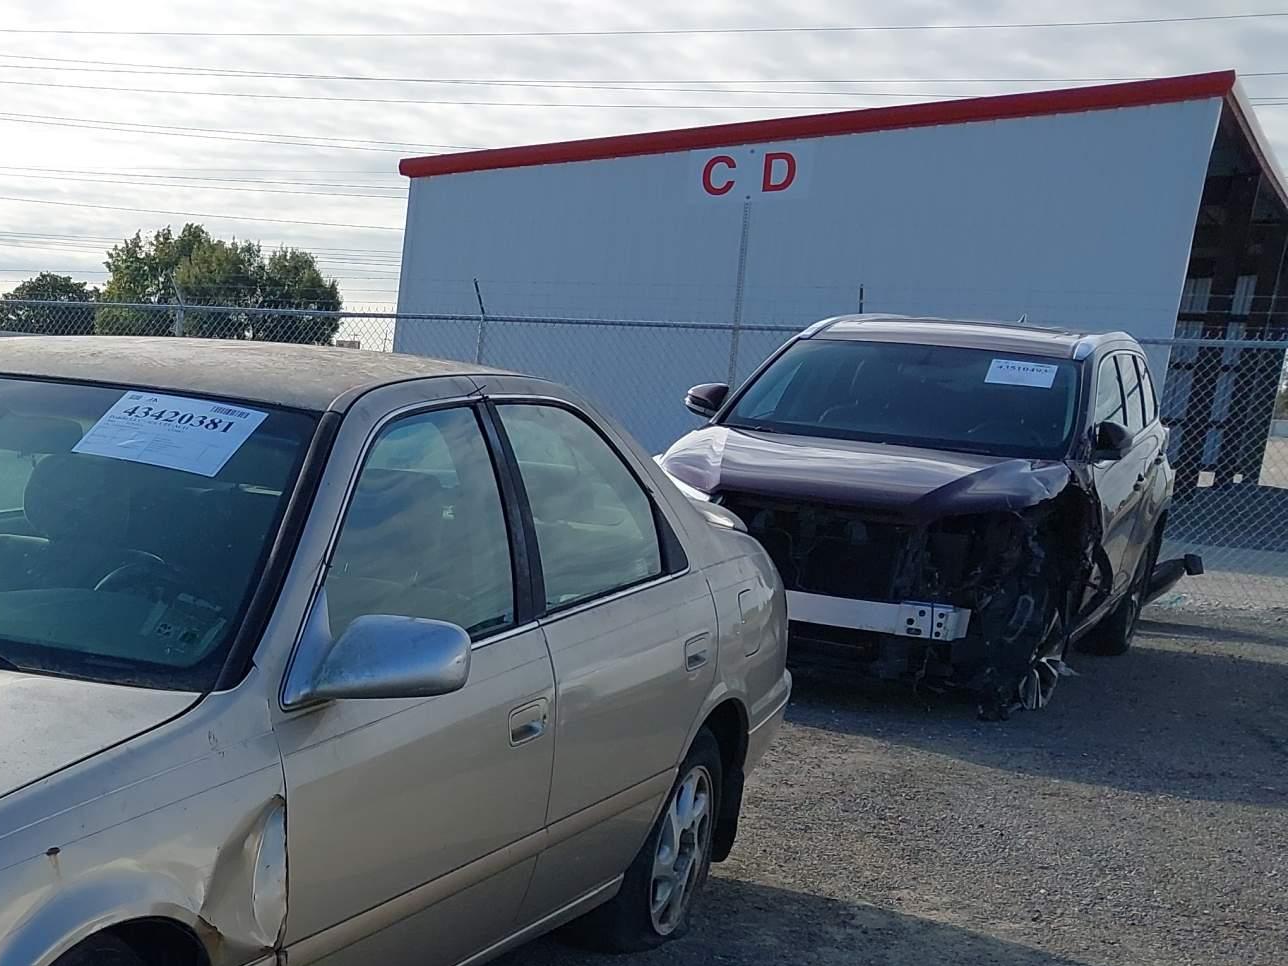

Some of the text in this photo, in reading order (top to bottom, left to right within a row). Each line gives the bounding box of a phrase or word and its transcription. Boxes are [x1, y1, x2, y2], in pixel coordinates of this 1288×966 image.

[702, 152, 797, 196] C D
[123, 405, 234, 433] 43420381
